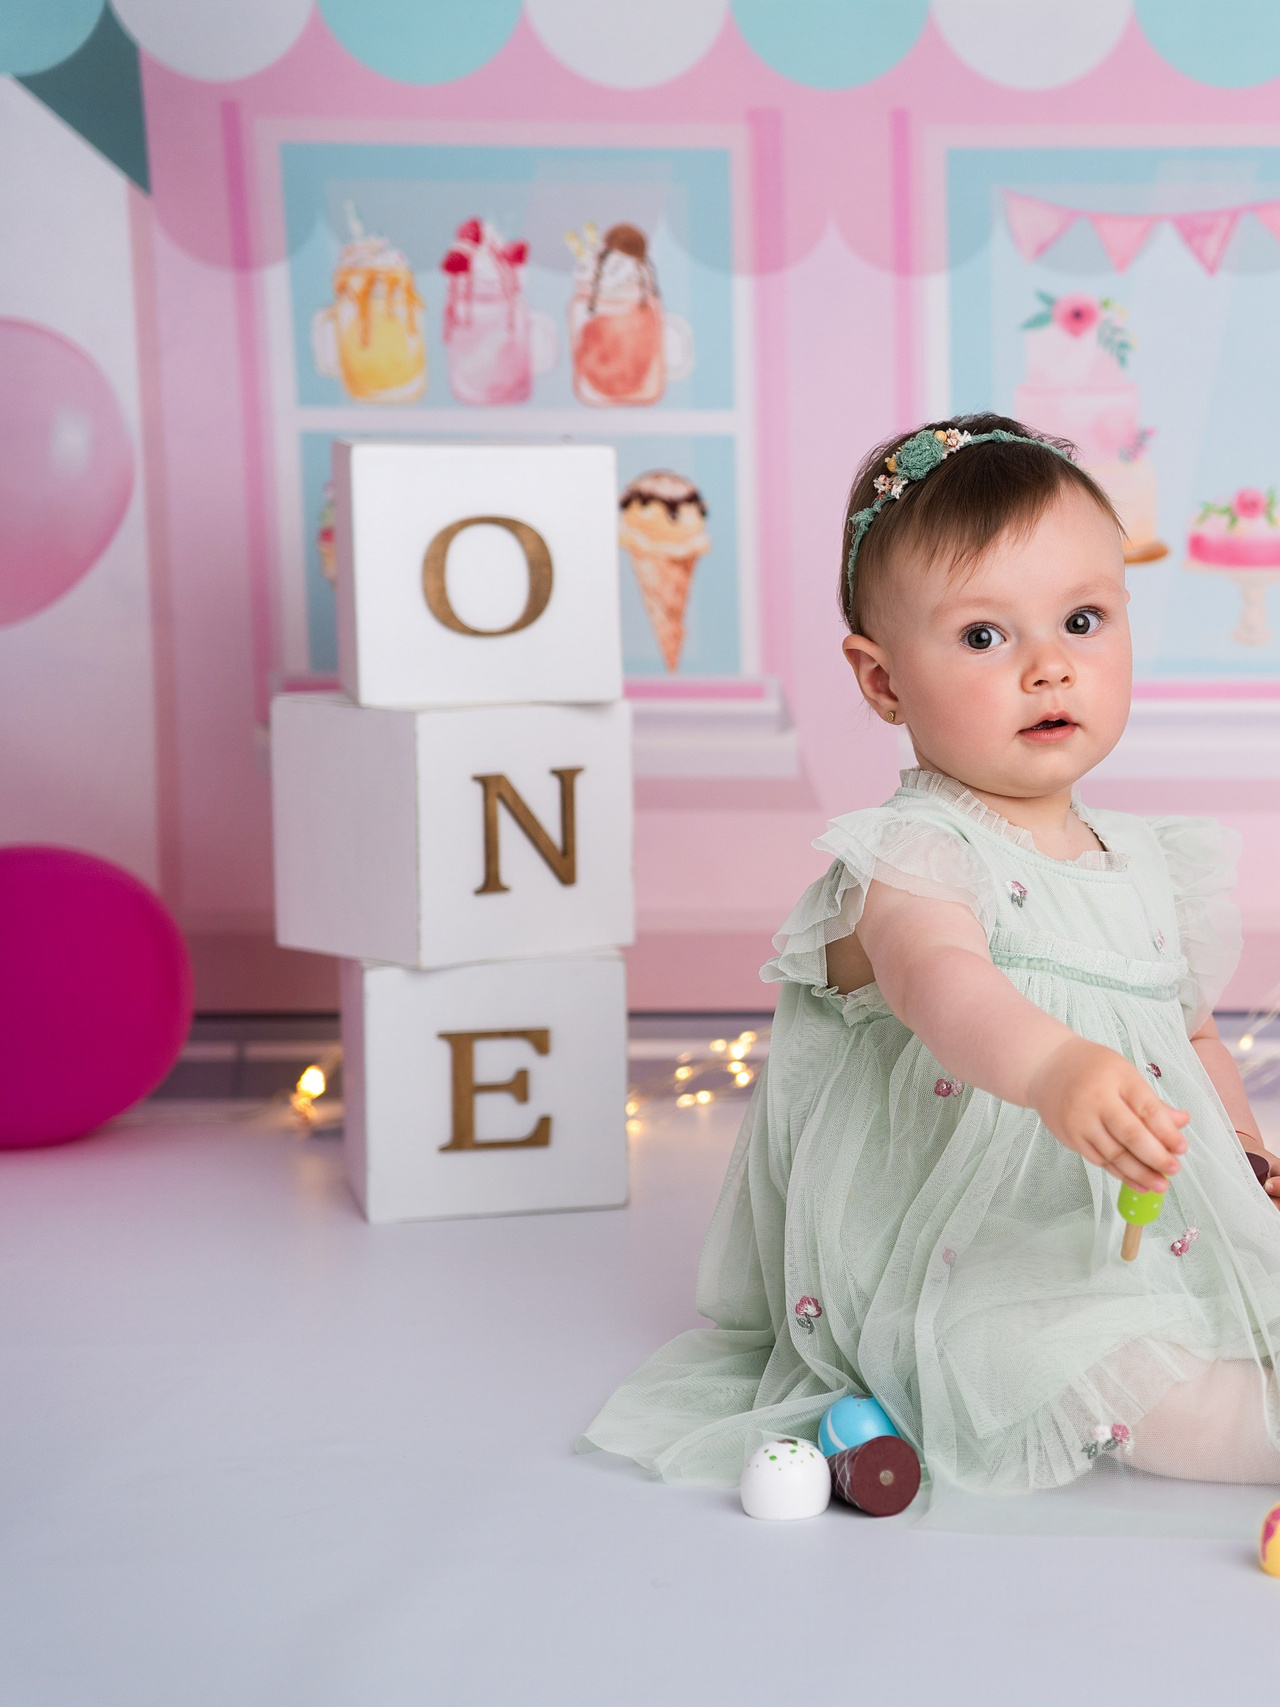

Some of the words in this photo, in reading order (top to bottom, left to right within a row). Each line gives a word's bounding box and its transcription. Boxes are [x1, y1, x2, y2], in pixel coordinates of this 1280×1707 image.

[422, 515, 555, 639] O
[471, 766, 585, 897] N
[436, 1025, 555, 1155] E
